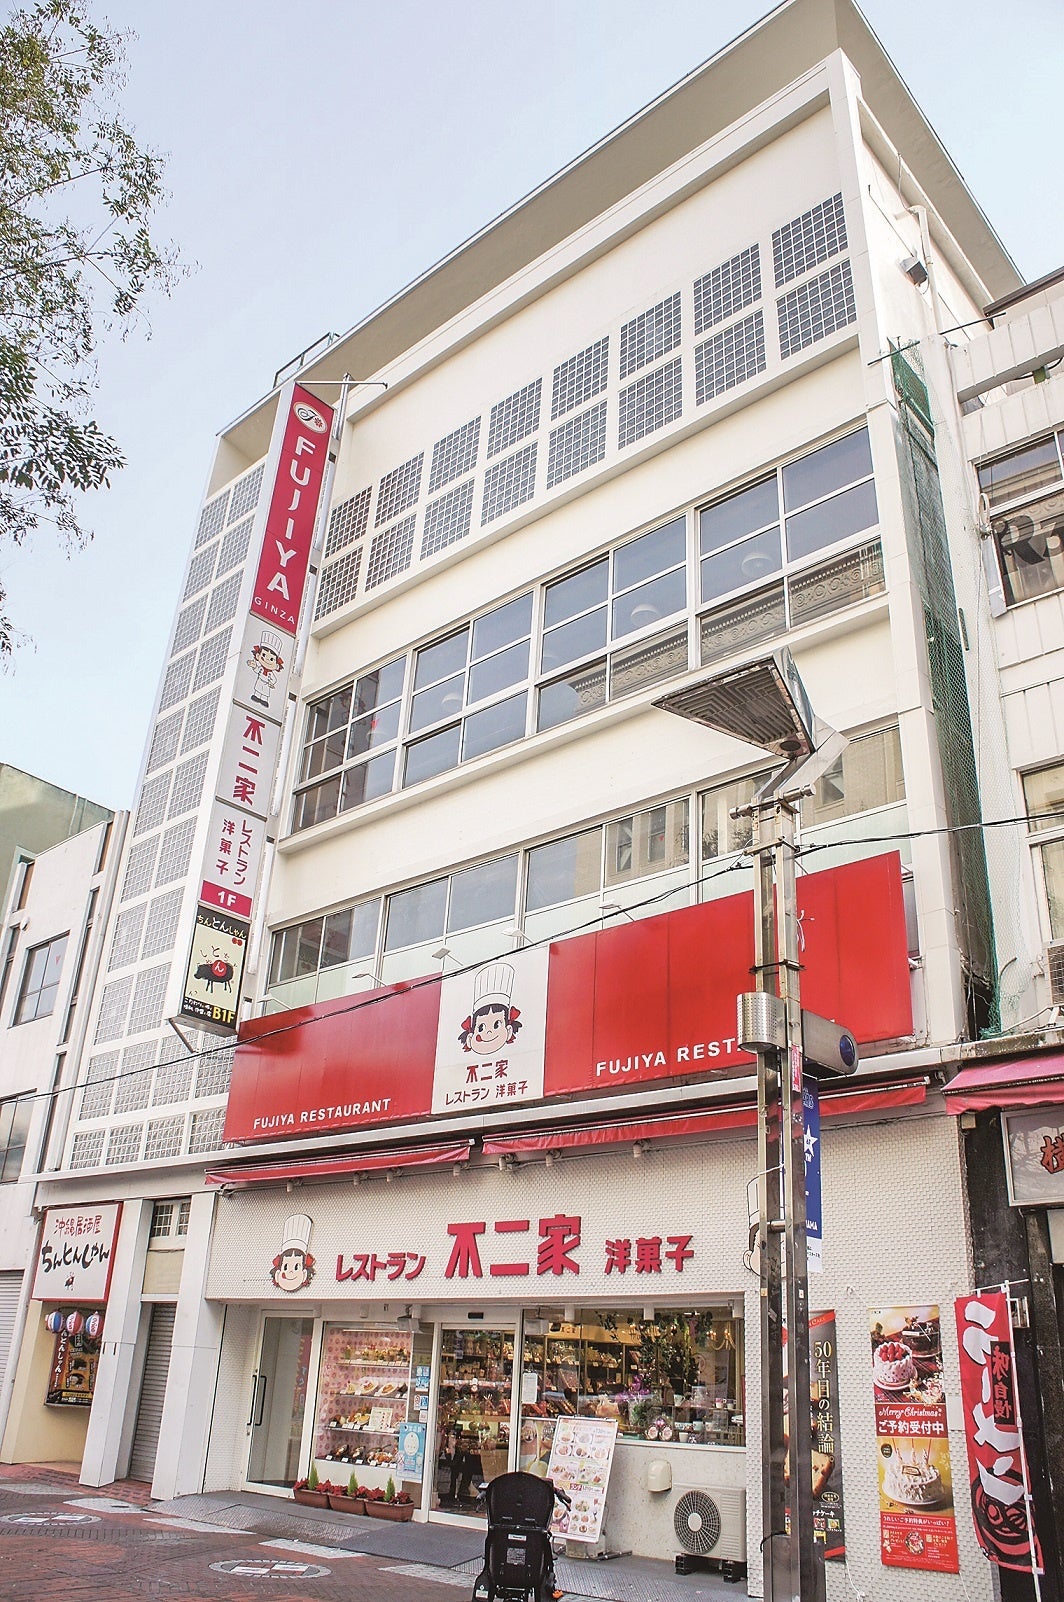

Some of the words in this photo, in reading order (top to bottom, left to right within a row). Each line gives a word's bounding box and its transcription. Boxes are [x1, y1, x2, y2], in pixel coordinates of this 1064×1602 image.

[266, 435, 316, 601] FUJIYA
[254, 596, 296, 625] GINZA
[233, 715, 266, 806] 不二家
[215, 818, 237, 875] 洋菓子
[233, 819, 253, 885] レストラン
[217, 890, 237, 906] 1F
[196, 914, 247, 939] ちんとんしゃん
[212, 1006, 236, 1024] B1F
[465, 1059, 509, 1084] 不二家
[595, 1052, 667, 1077] FUJIYA
[677, 1037, 741, 1063] REST
[445, 1087, 490, 1106] レストラン
[495, 1080, 529, 1099] 洋菓子
[253, 1113, 295, 1130] FUJIYA
[300, 1098, 392, 1124] RESTAURANT
[53, 1214, 103, 1237] 沖縄居酒屋
[41, 1239, 110, 1273] ちんとんしゃん
[335, 1252, 427, 1282] レストラン
[444, 1214, 582, 1278] 不二家
[604, 1234, 695, 1274] 洋菓子
[878, 1420, 944, 1435] ご予約受付中
